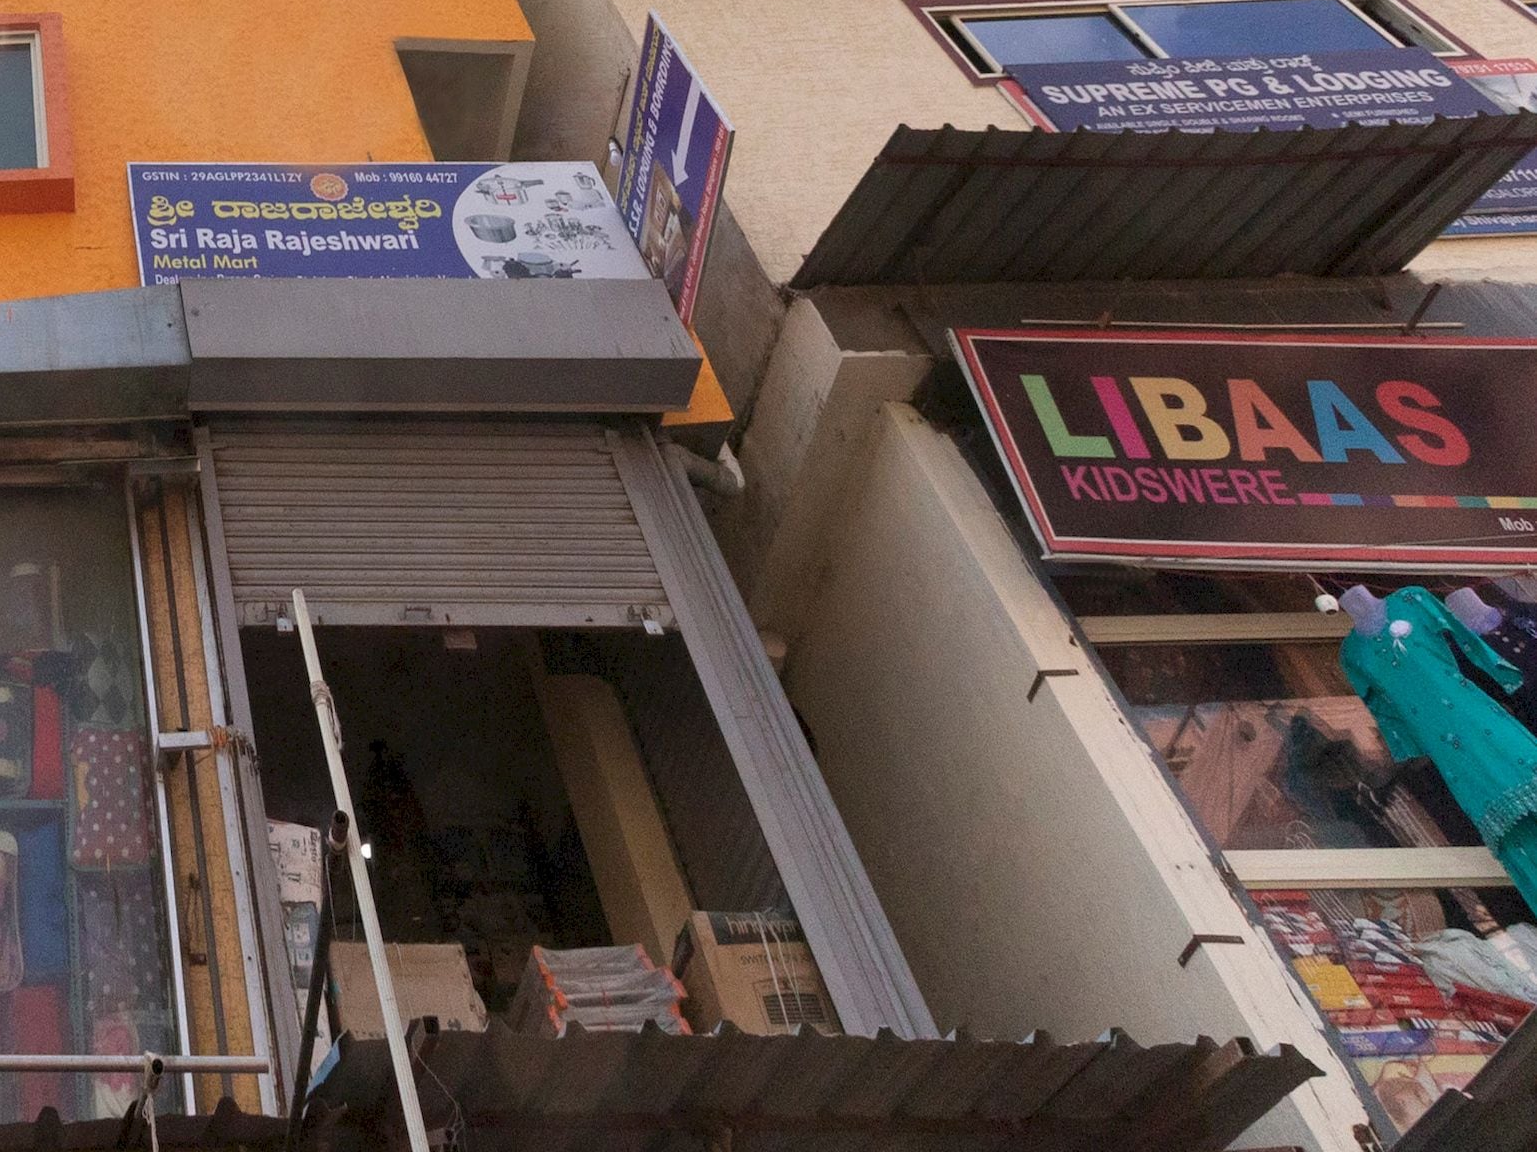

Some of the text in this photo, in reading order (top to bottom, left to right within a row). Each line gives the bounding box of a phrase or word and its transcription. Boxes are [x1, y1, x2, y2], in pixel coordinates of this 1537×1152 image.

[1041, 67, 1454, 106] SUPREME PG & LODGING
[1097, 90, 1435, 118] AN EX SERVICEMEN ENTERPRISES
[142, 171, 180, 182] GSTIN
[354, 172, 381, 183] Mob
[389, 173, 424, 184] 99160
[635, 129, 656, 201] LODGING
[147, 195, 442, 231] ಶ್ರೀ ರಾಜರಾಜೇಶ್ವರಿ
[150, 228, 420, 257] Sri Raja Rajeshwari
[153, 254, 259, 269] Metal Mart
[1019, 373, 1472, 468] LIBAAS
[1060, 465, 1298, 507] KIDSWERE
[1498, 516, 1535, 532] Mob
